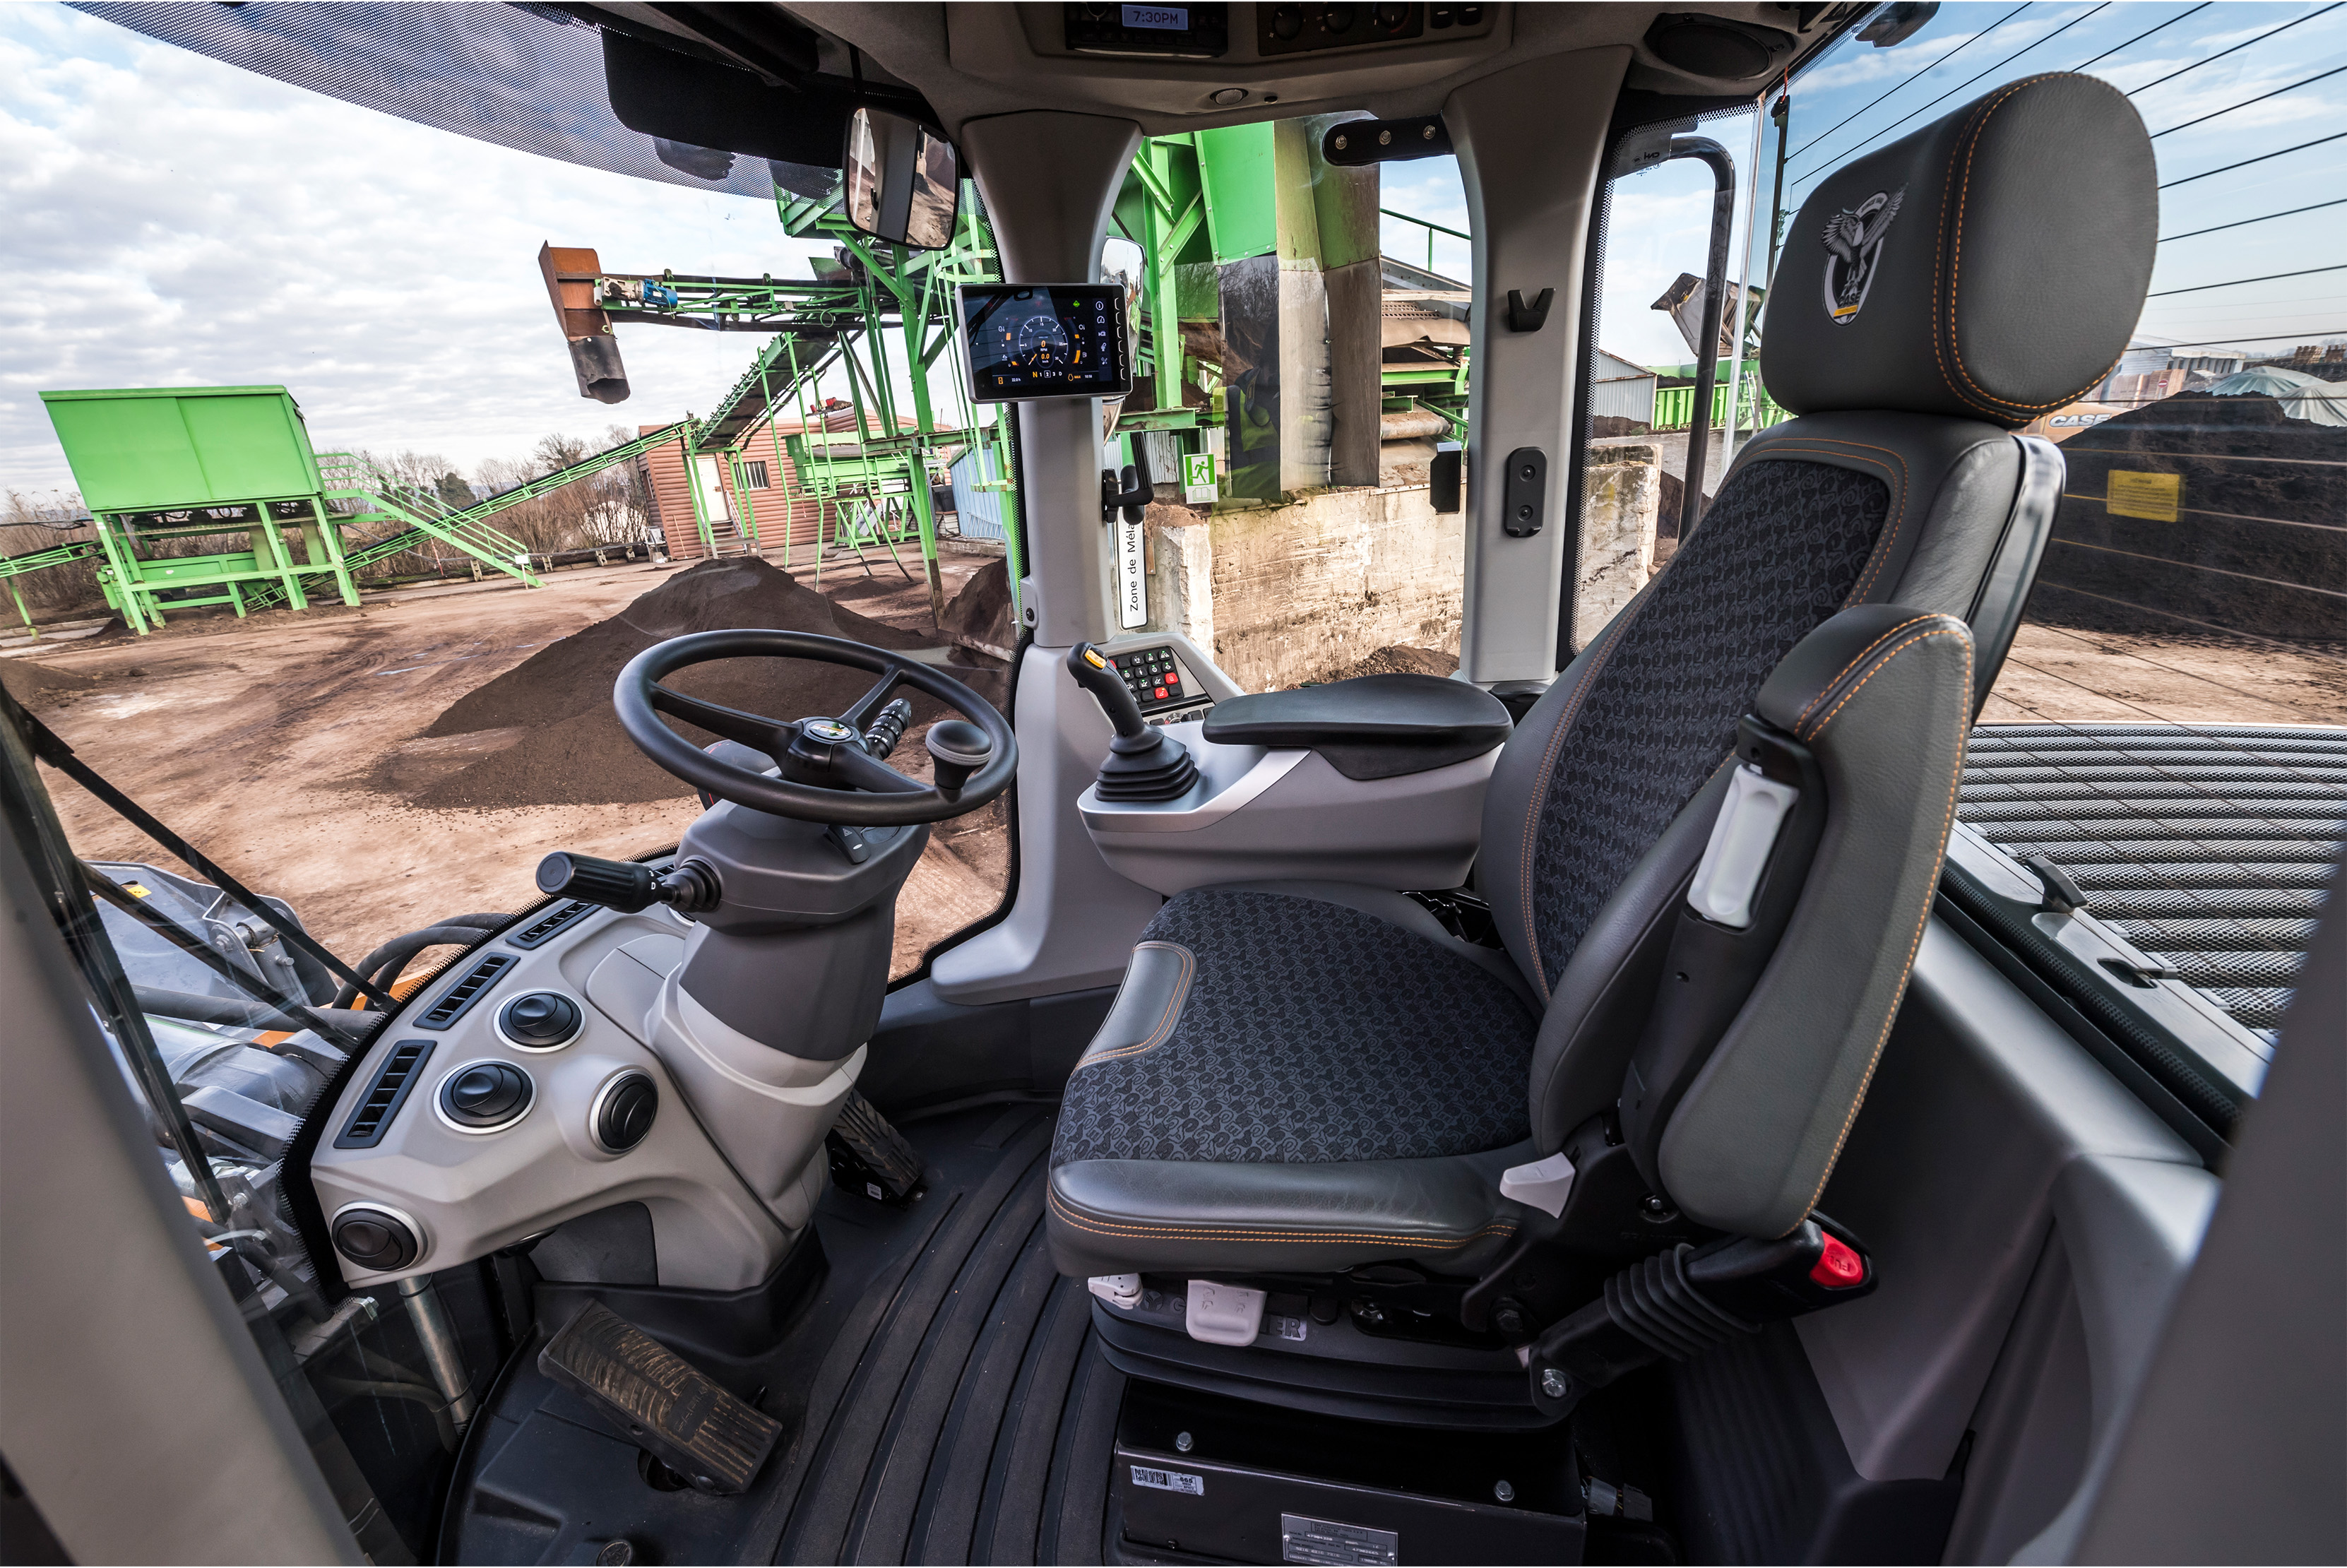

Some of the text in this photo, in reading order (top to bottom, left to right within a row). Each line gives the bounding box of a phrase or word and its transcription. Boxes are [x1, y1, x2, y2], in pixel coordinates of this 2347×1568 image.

[1132, 11, 1179, 25] 7:30PM
[1838, 290, 1861, 307] CASE
[2050, 413, 2113, 427] CASE
[1127, 559, 1136, 574] de
[1129, 581, 1139, 612] Zone
[650, 881, 656, 890] D
